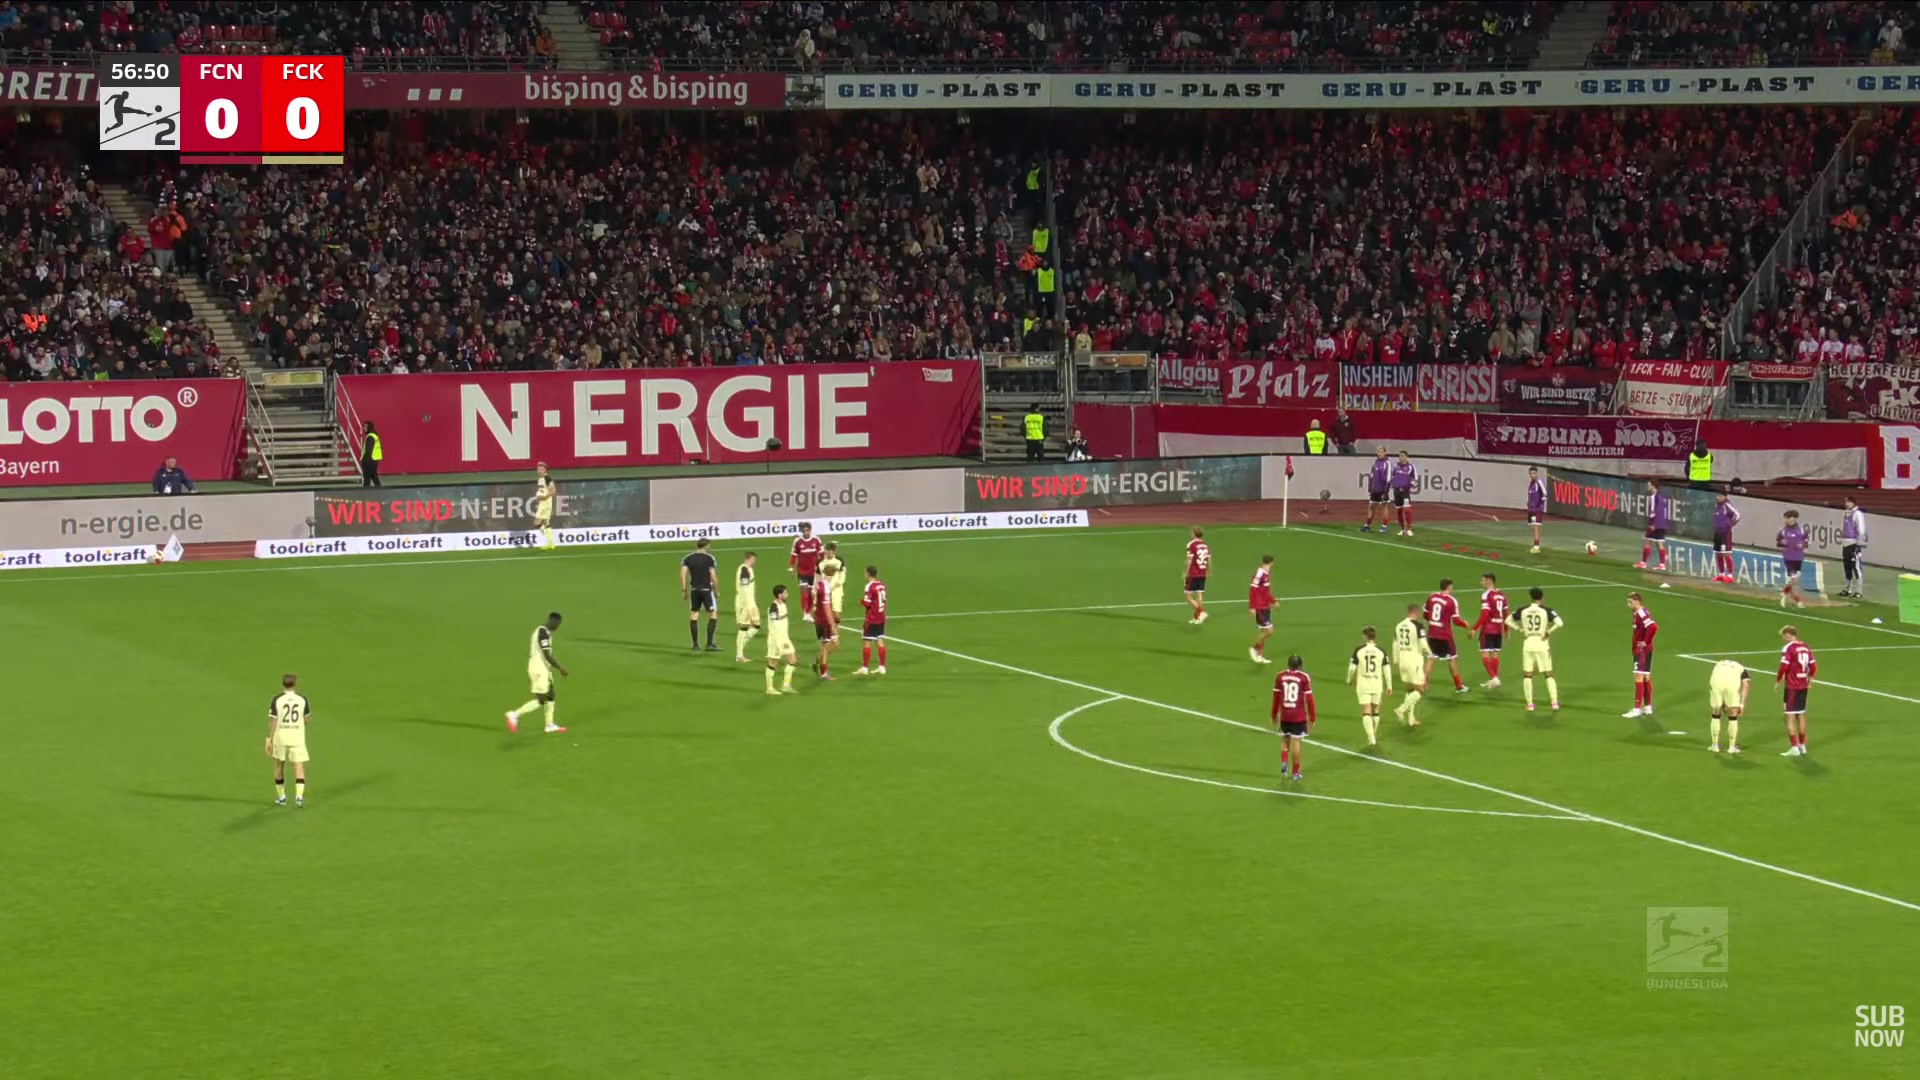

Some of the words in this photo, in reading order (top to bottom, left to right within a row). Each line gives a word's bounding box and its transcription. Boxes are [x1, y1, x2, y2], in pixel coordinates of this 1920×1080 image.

[0, 71, 100, 101] REIT
[524, 75, 622, 105] bisping
[628, 75, 648, 99] &
[653, 75, 748, 105] bisping
[1159, 359, 1220, 386] Allgäu
[1227, 361, 1330, 405] Pfalz
[1418, 364, 1497, 402] CHRISSI
[1521, 385, 1540, 400] WIR
[1541, 387, 1564, 399] SIND
[1497, 426, 1602, 446] TRIBUNA
[1615, 425, 1676, 447] NORD
[1549, 446, 1624, 457] KAISERSLAUTERN
[977, 477, 1023, 499] WIR
[1031, 475, 1086, 498] SIND
[1553, 481, 1581, 507] WIR
[1584, 485, 1618, 511] SIND
[746, 483, 868, 512] n-ergie.de
[328, 501, 381, 525] WIR
[391, 499, 452, 523] SIND
[1008, 512, 1078, 527] toolcraft
[61, 507, 203, 539] n-ergie.de
[829, 518, 898, 532] toolcraft
[918, 514, 988, 529] toolcraft
[464, 533, 537, 548] toolcraft
[558, 529, 630, 543] toolcraft
[649, 526, 720, 540] toolcraft
[270, 540, 347, 555] toolcraft
[368, 537, 443, 551] toolcraft
[65, 548, 147, 563] toolcraft
[1432, 603, 1442, 621] 8
[1526, 614, 1541, 631] 39
[1364, 655, 1377, 672] 15
[1282, 681, 1299, 702] 18
[282, 703, 299, 724] 26
